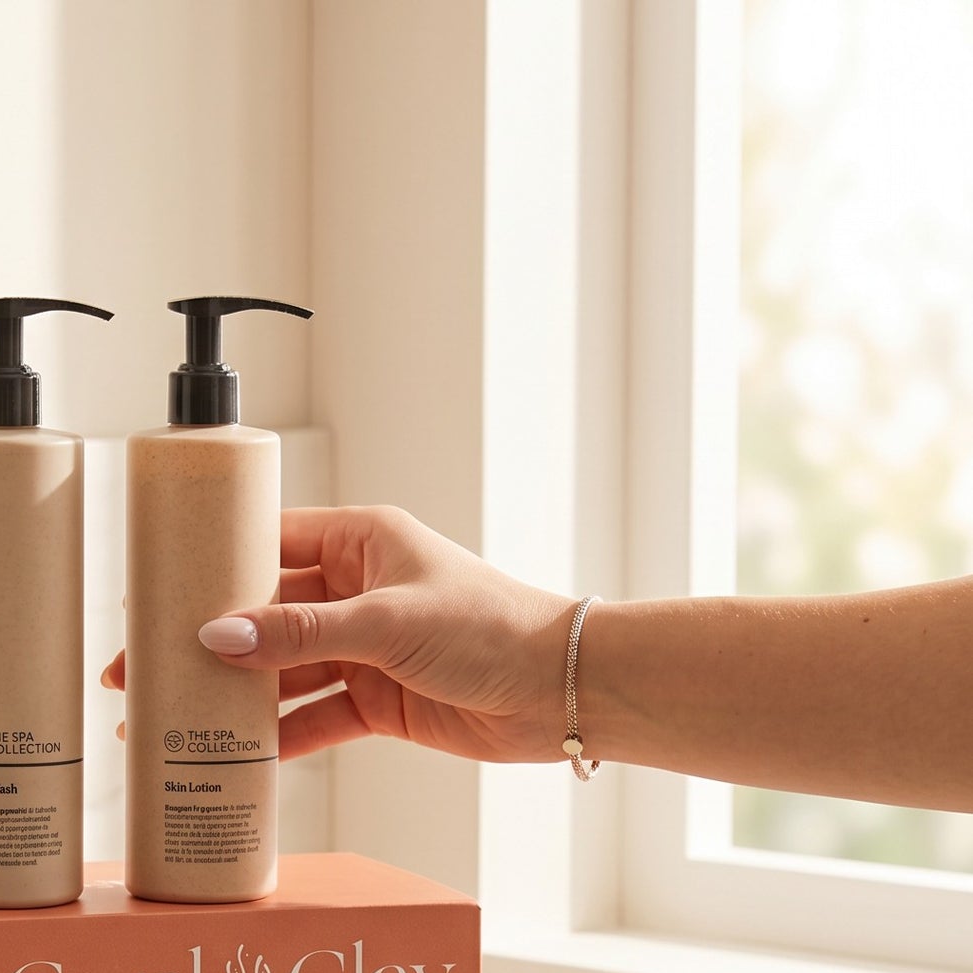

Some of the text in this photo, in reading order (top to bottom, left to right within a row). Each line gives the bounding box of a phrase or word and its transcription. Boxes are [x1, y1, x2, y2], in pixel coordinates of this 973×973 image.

[12, 731, 34, 742] SPA
[188, 730, 235, 741] THE SPA
[188, 740, 260, 753] COLLECTION
[164, 781, 222, 793] Skin Lotion
